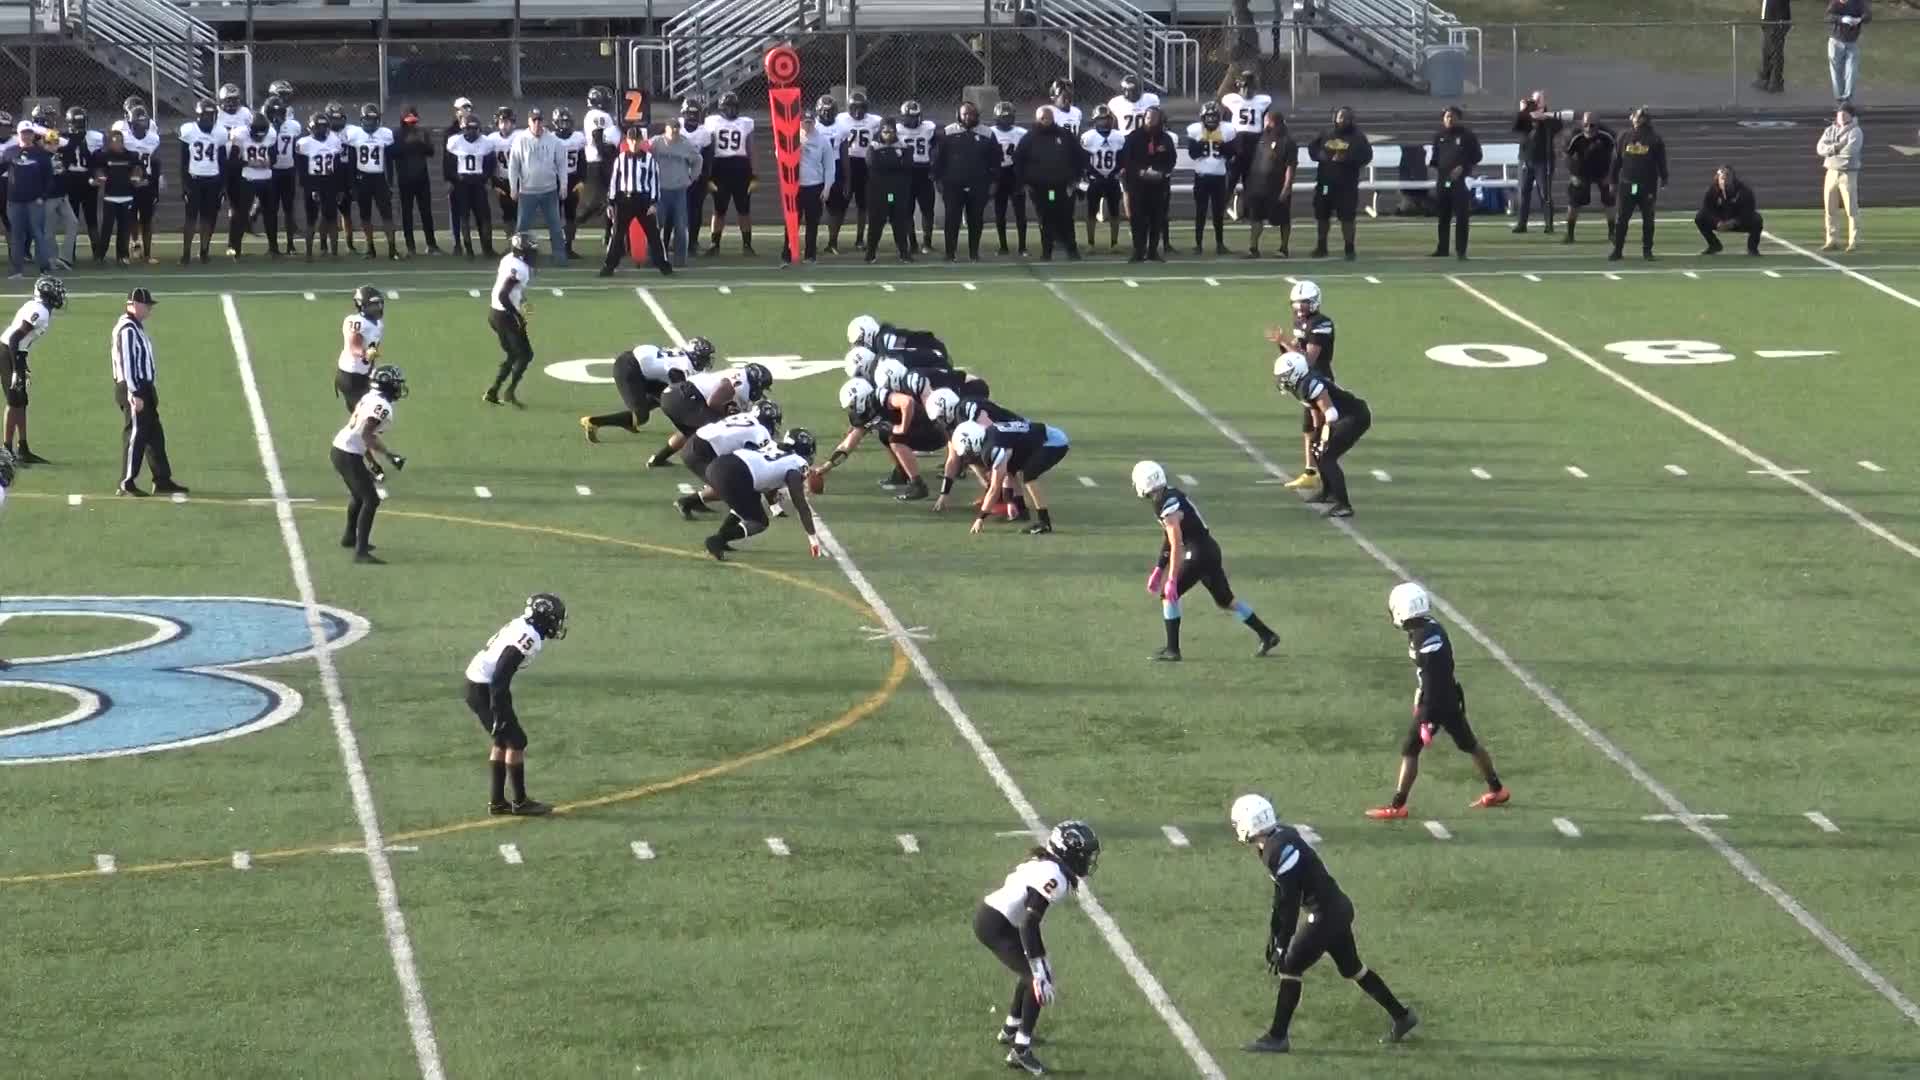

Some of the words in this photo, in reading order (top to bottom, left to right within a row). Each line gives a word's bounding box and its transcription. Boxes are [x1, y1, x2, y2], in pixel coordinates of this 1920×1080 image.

[624, 91, 643, 121] 2
[1239, 109, 1256, 126] 51
[718, 129, 741, 150] 59
[193, 141, 215, 161] 34
[360, 145, 381, 166] 84
[517, 633, 535, 651] 15
[1043, 878, 1059, 895] 2
